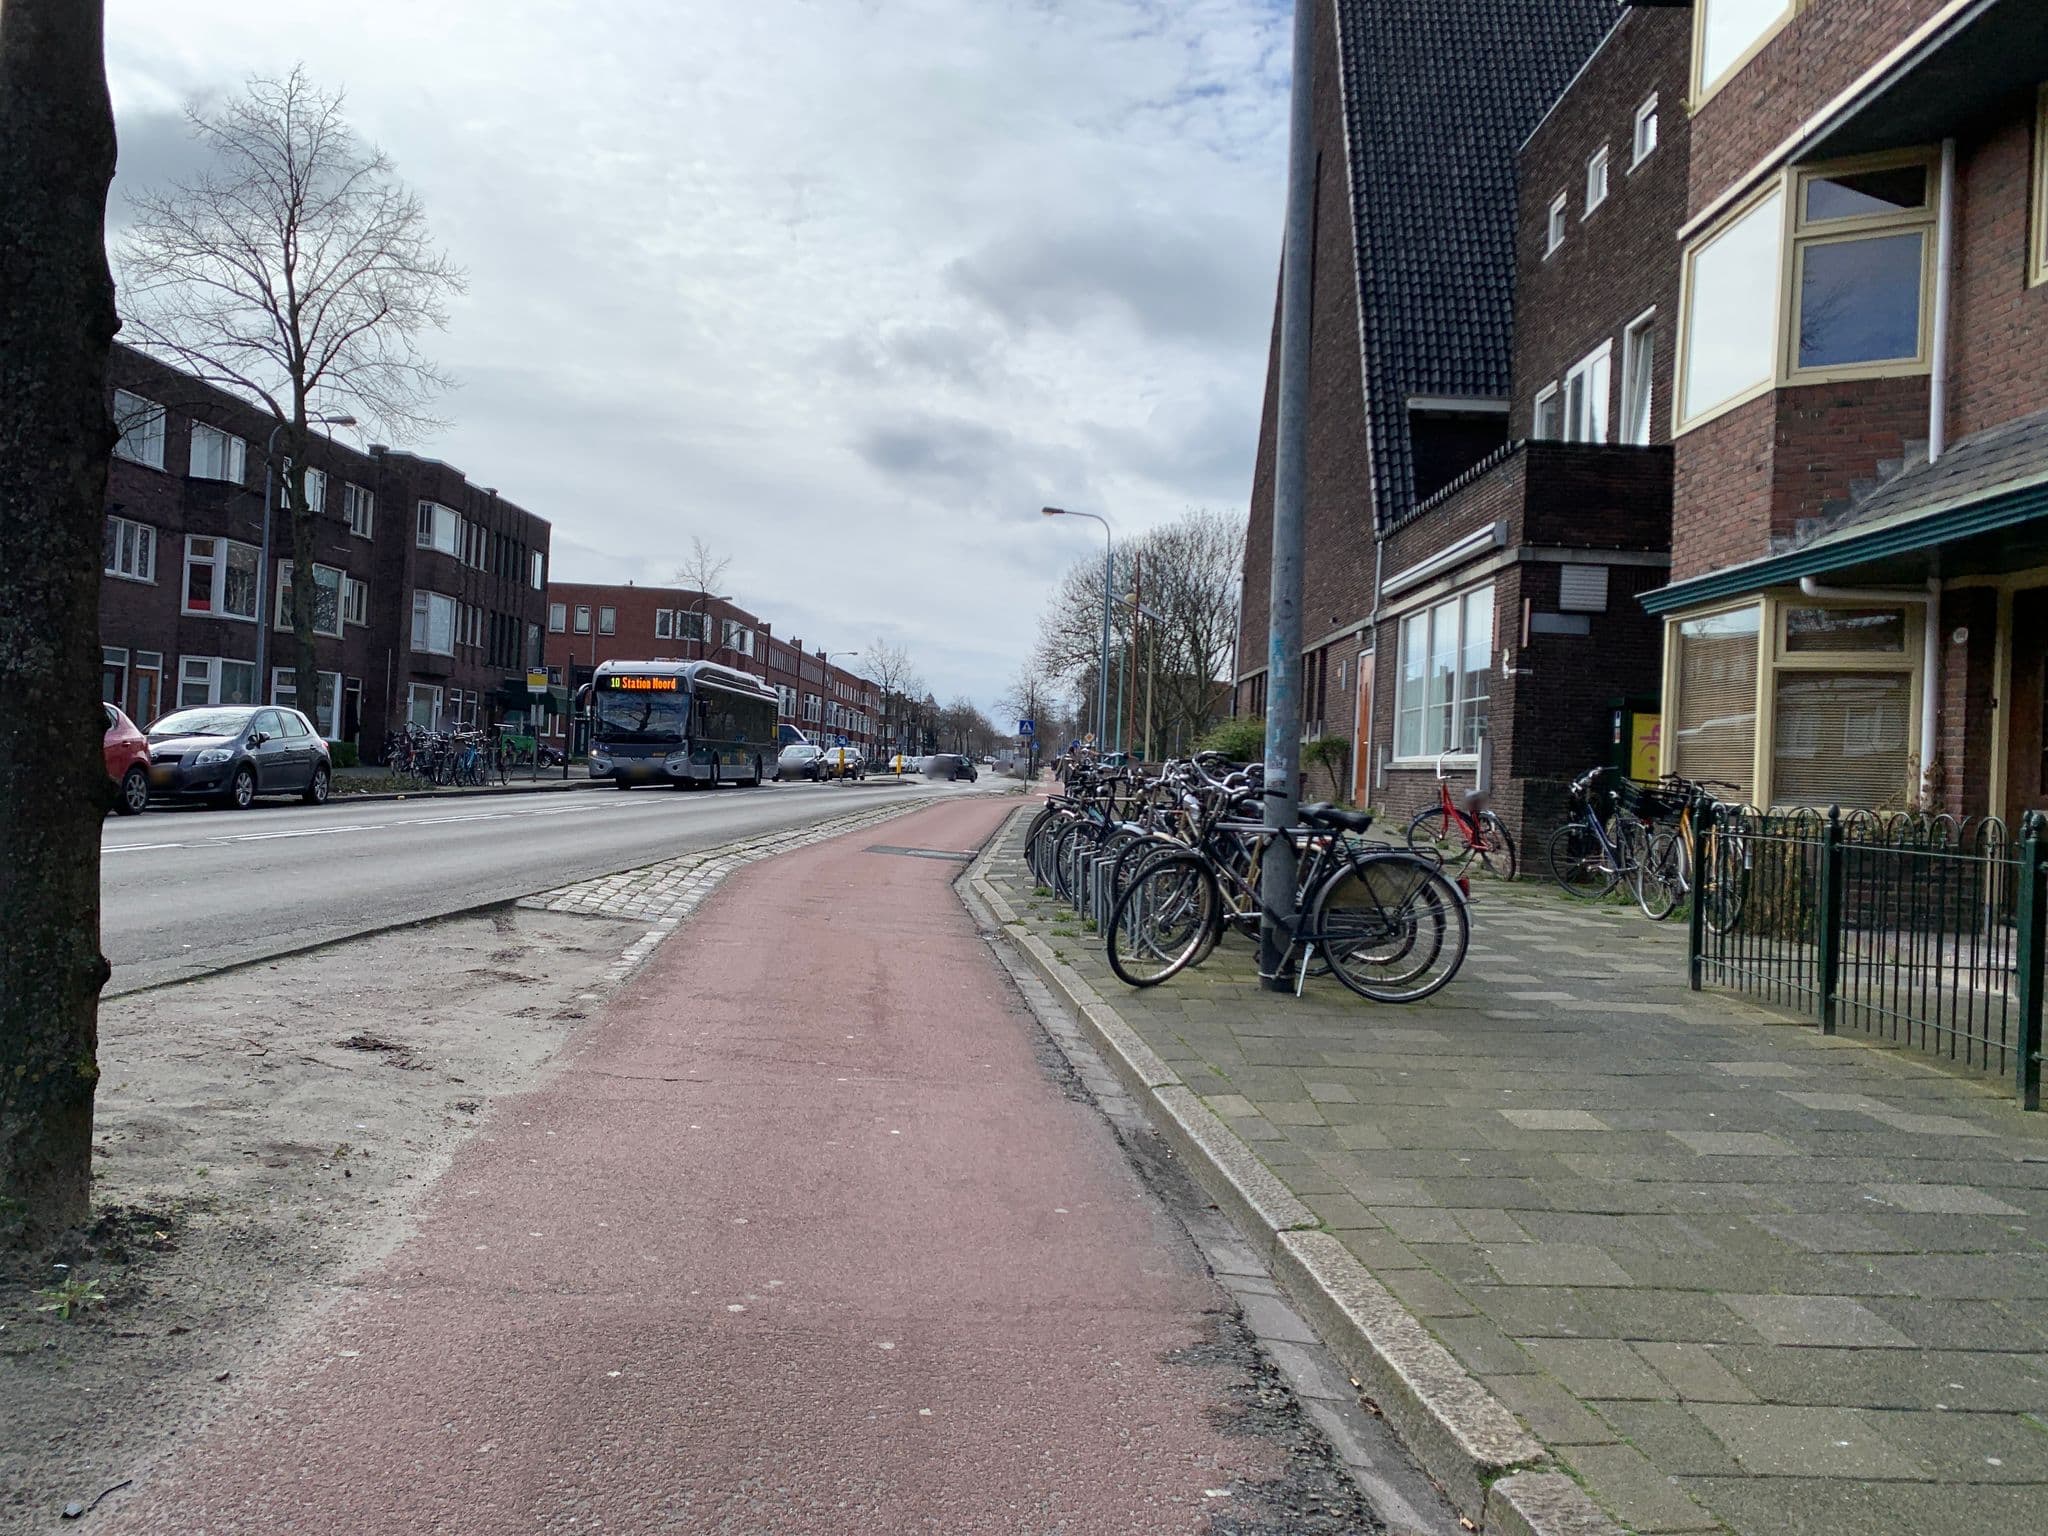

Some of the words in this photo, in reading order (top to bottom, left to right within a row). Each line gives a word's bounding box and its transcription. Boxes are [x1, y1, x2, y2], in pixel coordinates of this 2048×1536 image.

[611, 677, 620, 688] 10
[622, 676, 651, 689] Station
[652, 677, 676, 689] Noord
